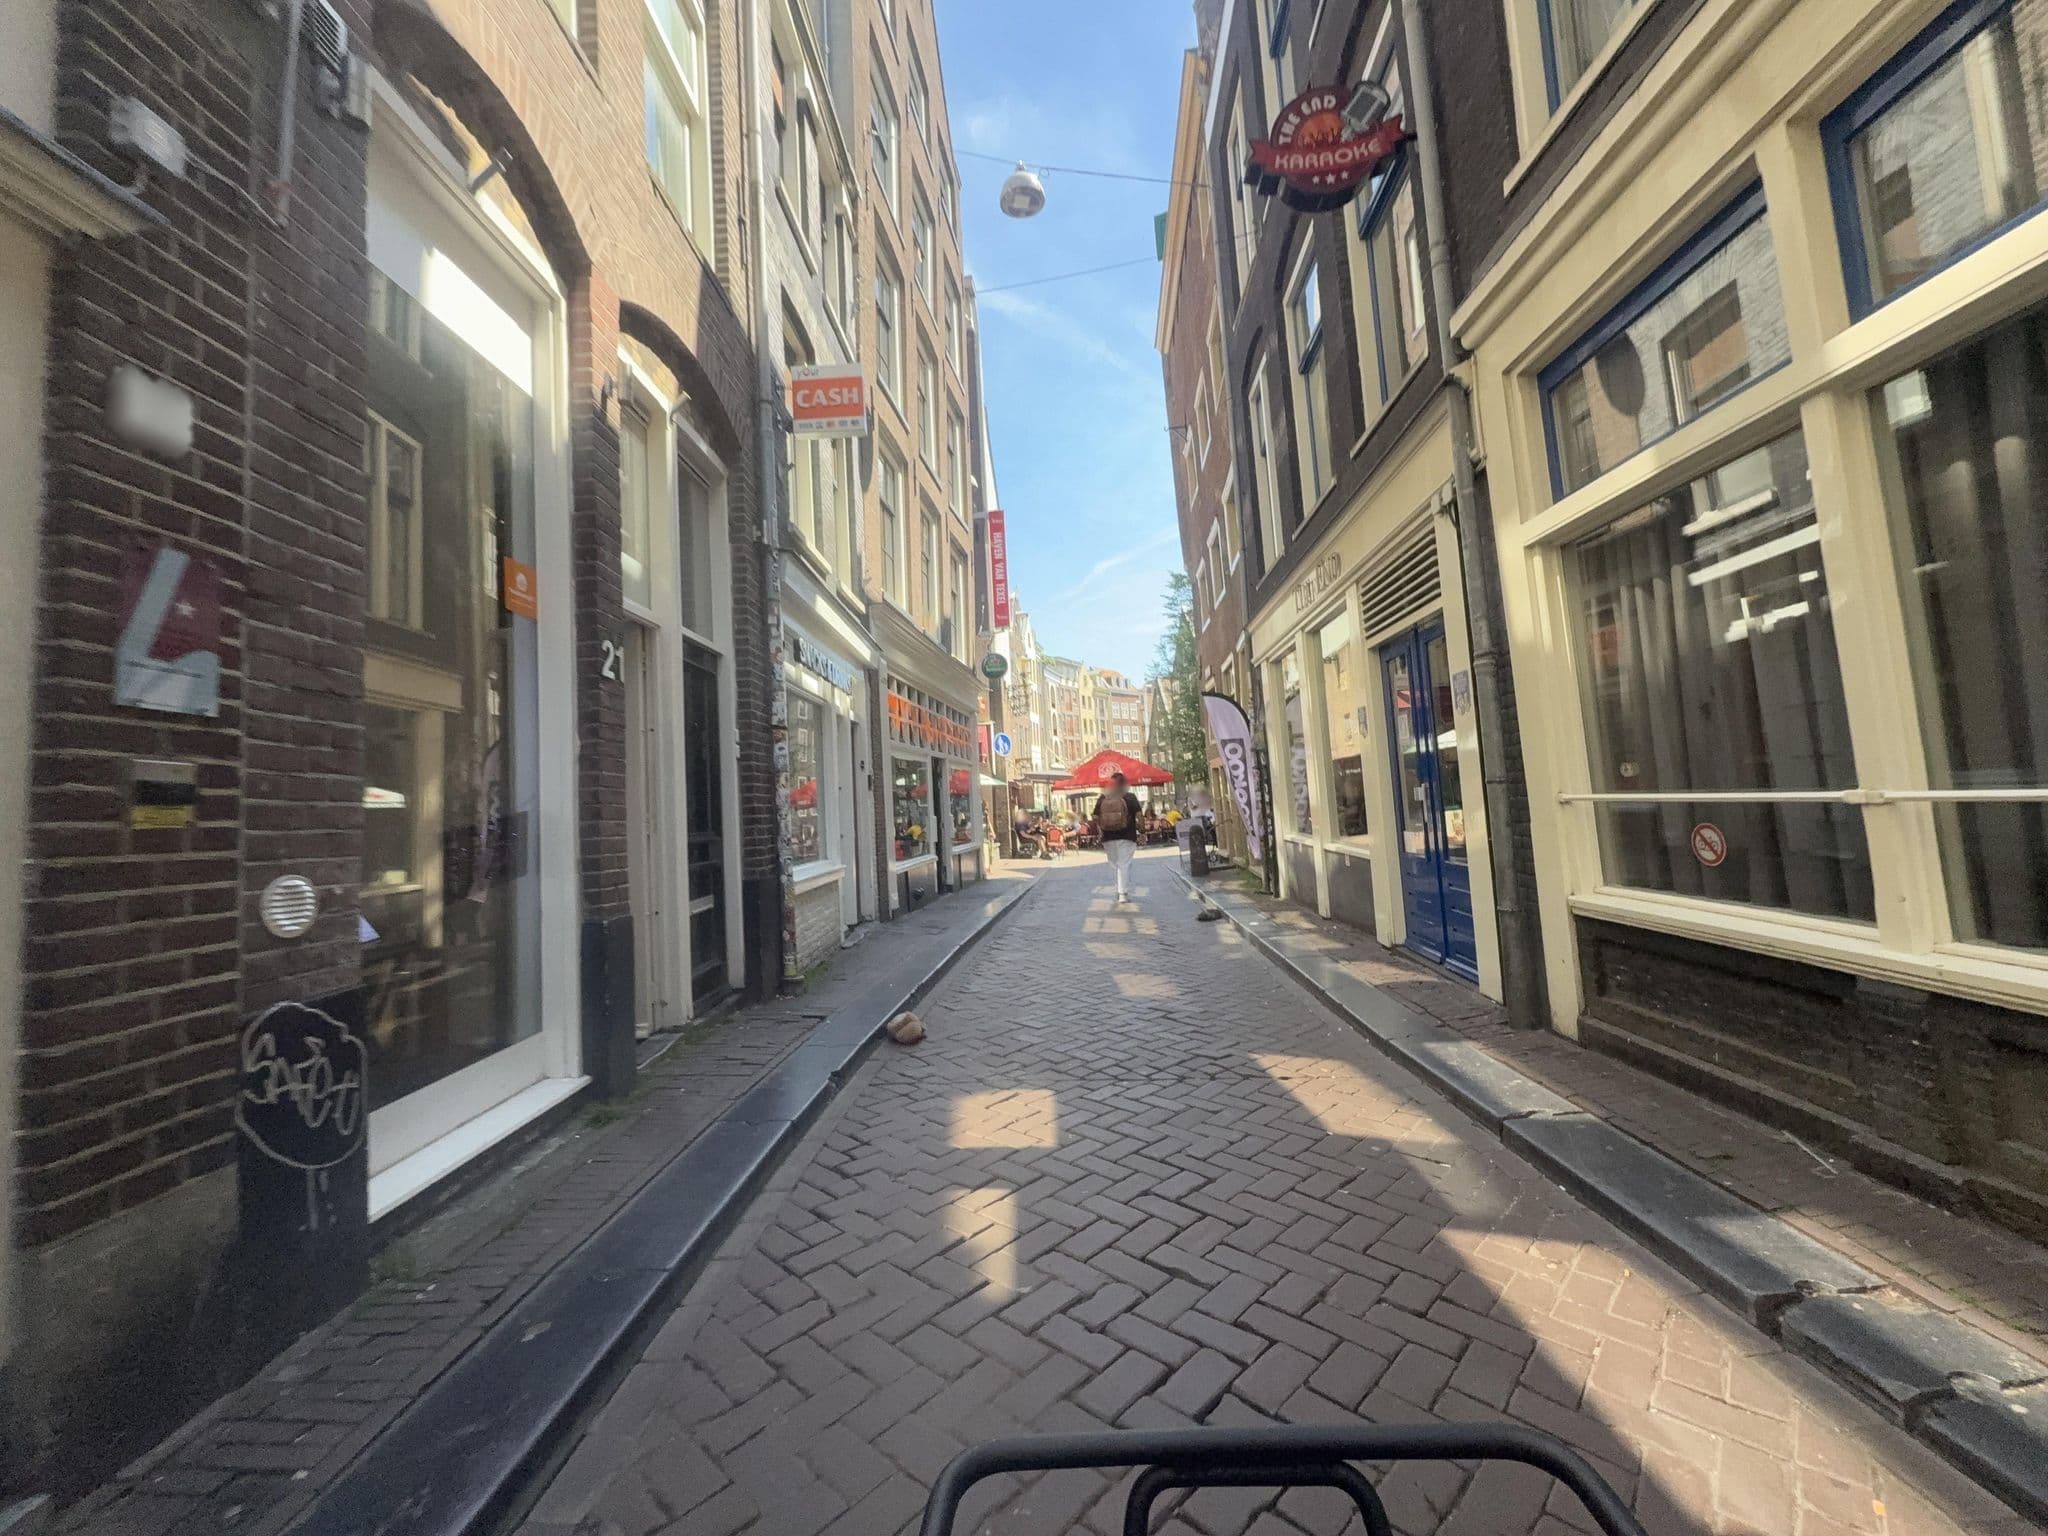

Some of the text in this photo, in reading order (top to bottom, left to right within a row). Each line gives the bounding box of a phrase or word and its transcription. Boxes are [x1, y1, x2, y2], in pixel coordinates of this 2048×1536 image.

[1278, 112, 1300, 145] THE
[1274, 138, 1382, 169] KARAOKE
[796, 387, 860, 409] CASH
[992, 531, 1005, 560] HAVEN
[994, 562, 1006, 580] VAN
[995, 583, 1007, 606] TEXEL
[601, 639, 625, 684] 21
